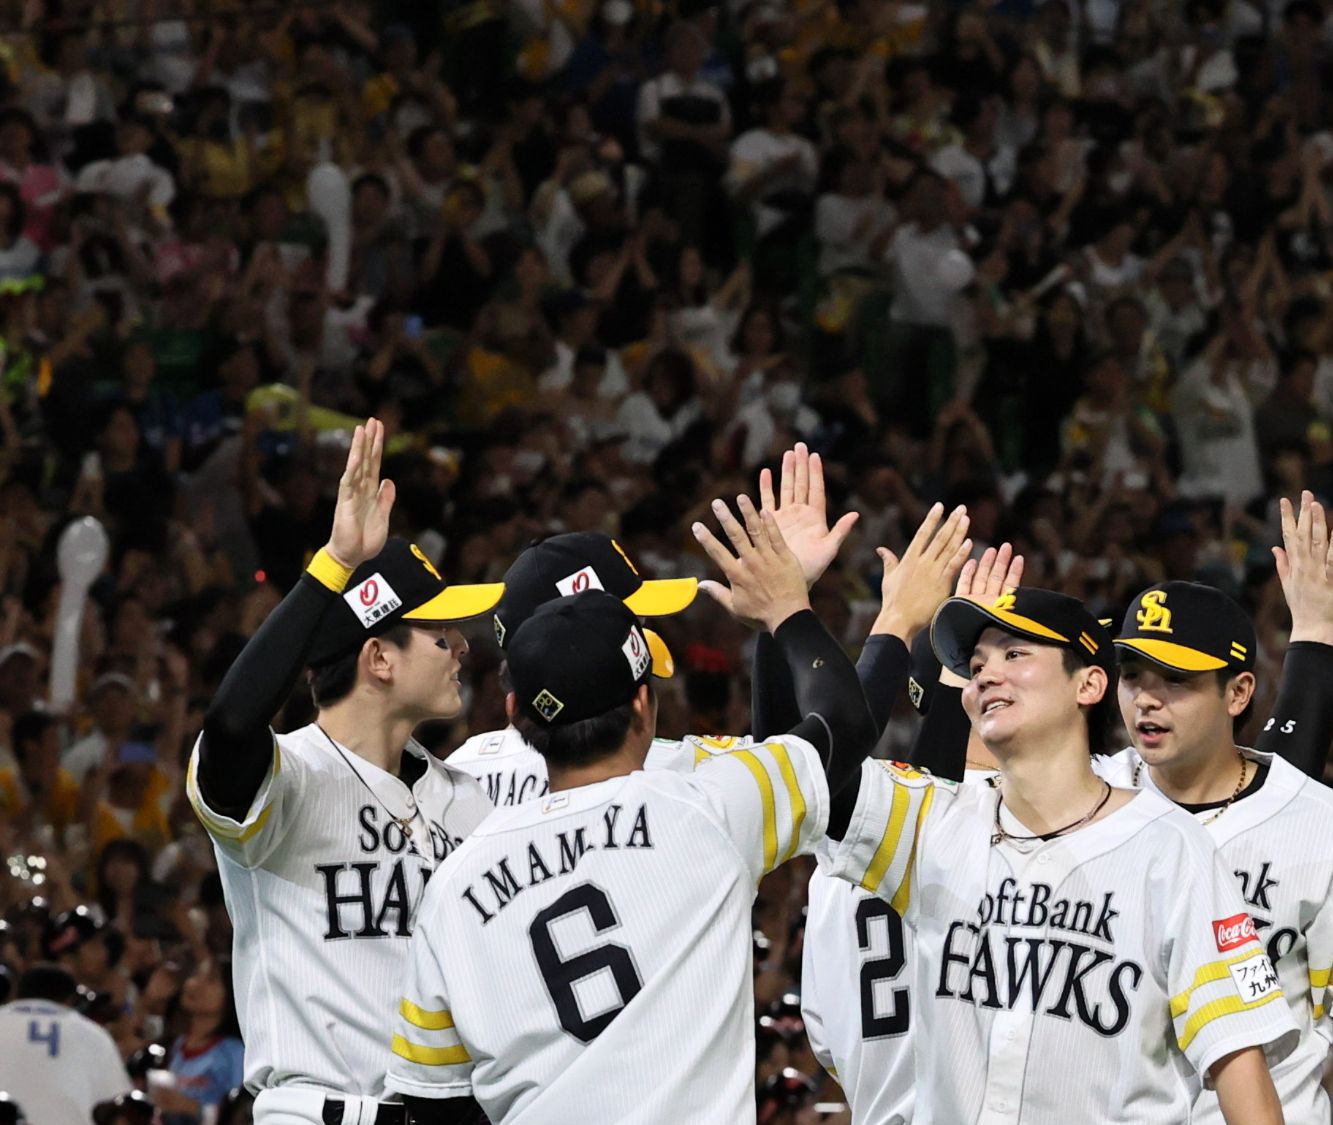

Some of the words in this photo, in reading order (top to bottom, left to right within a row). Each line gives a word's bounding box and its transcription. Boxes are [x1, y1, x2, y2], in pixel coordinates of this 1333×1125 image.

[462, 803, 655, 926] IMAMYA
[977, 877, 1119, 943] oftBank
[528, 879, 646, 1047] 6
[935, 921, 1144, 1037] HAWKS
